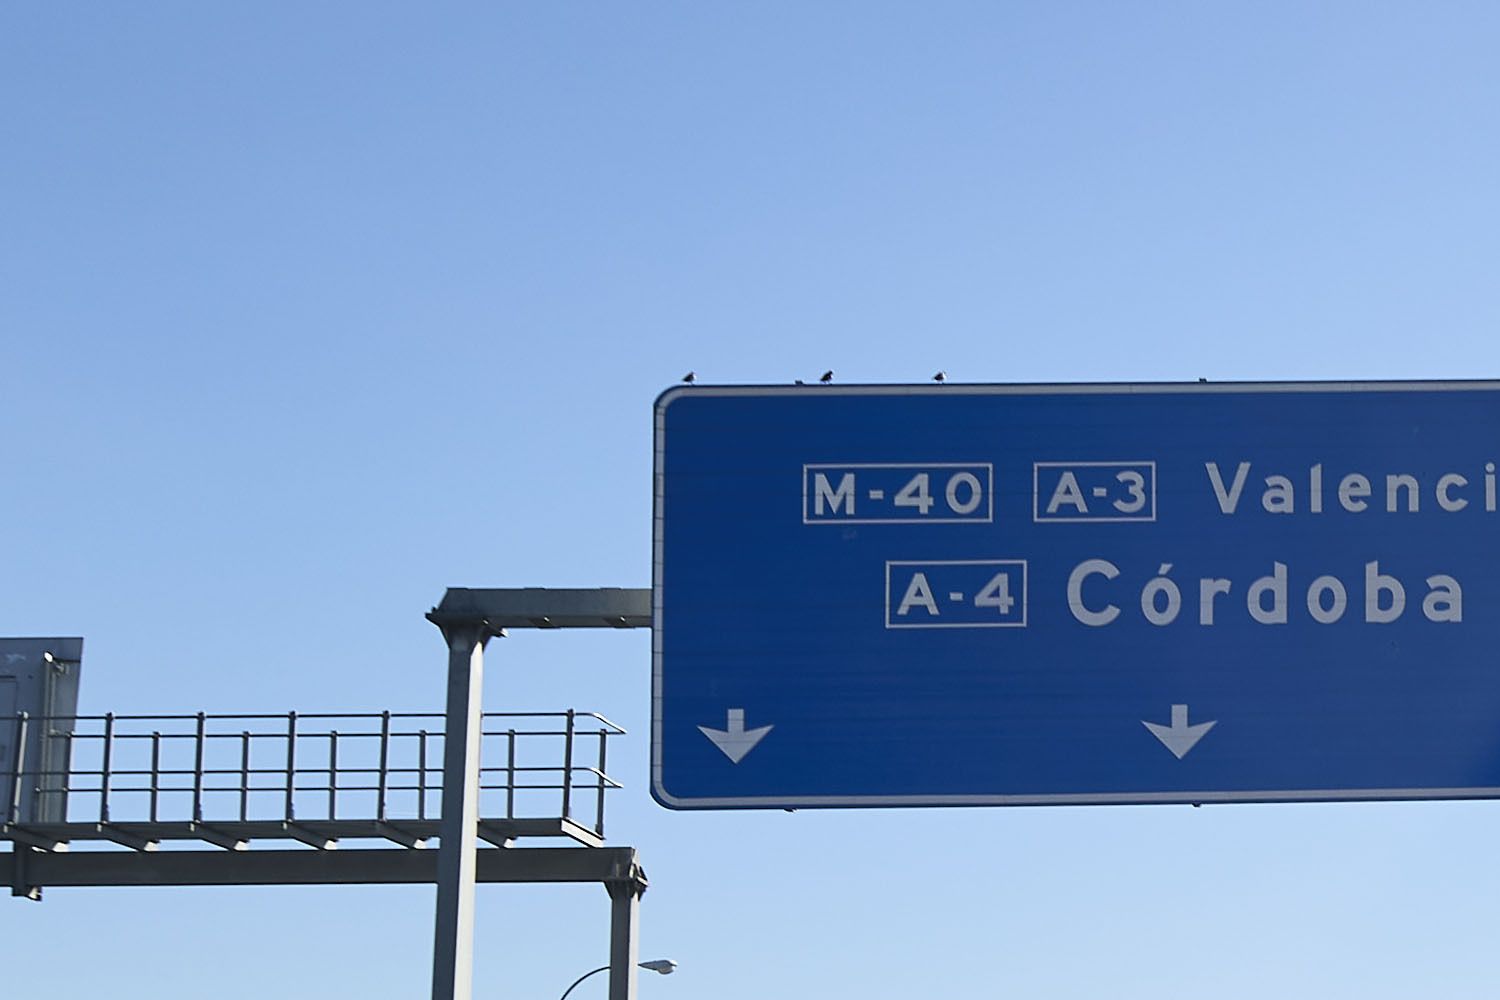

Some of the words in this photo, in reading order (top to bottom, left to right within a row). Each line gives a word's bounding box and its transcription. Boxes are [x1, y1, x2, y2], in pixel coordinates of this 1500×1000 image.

[815, 472, 982, 515] M-40
[1047, 472, 1146, 513] A-3
[898, 573, 1014, 615] A-4
[1067, 559, 1463, 626] Córdoba
